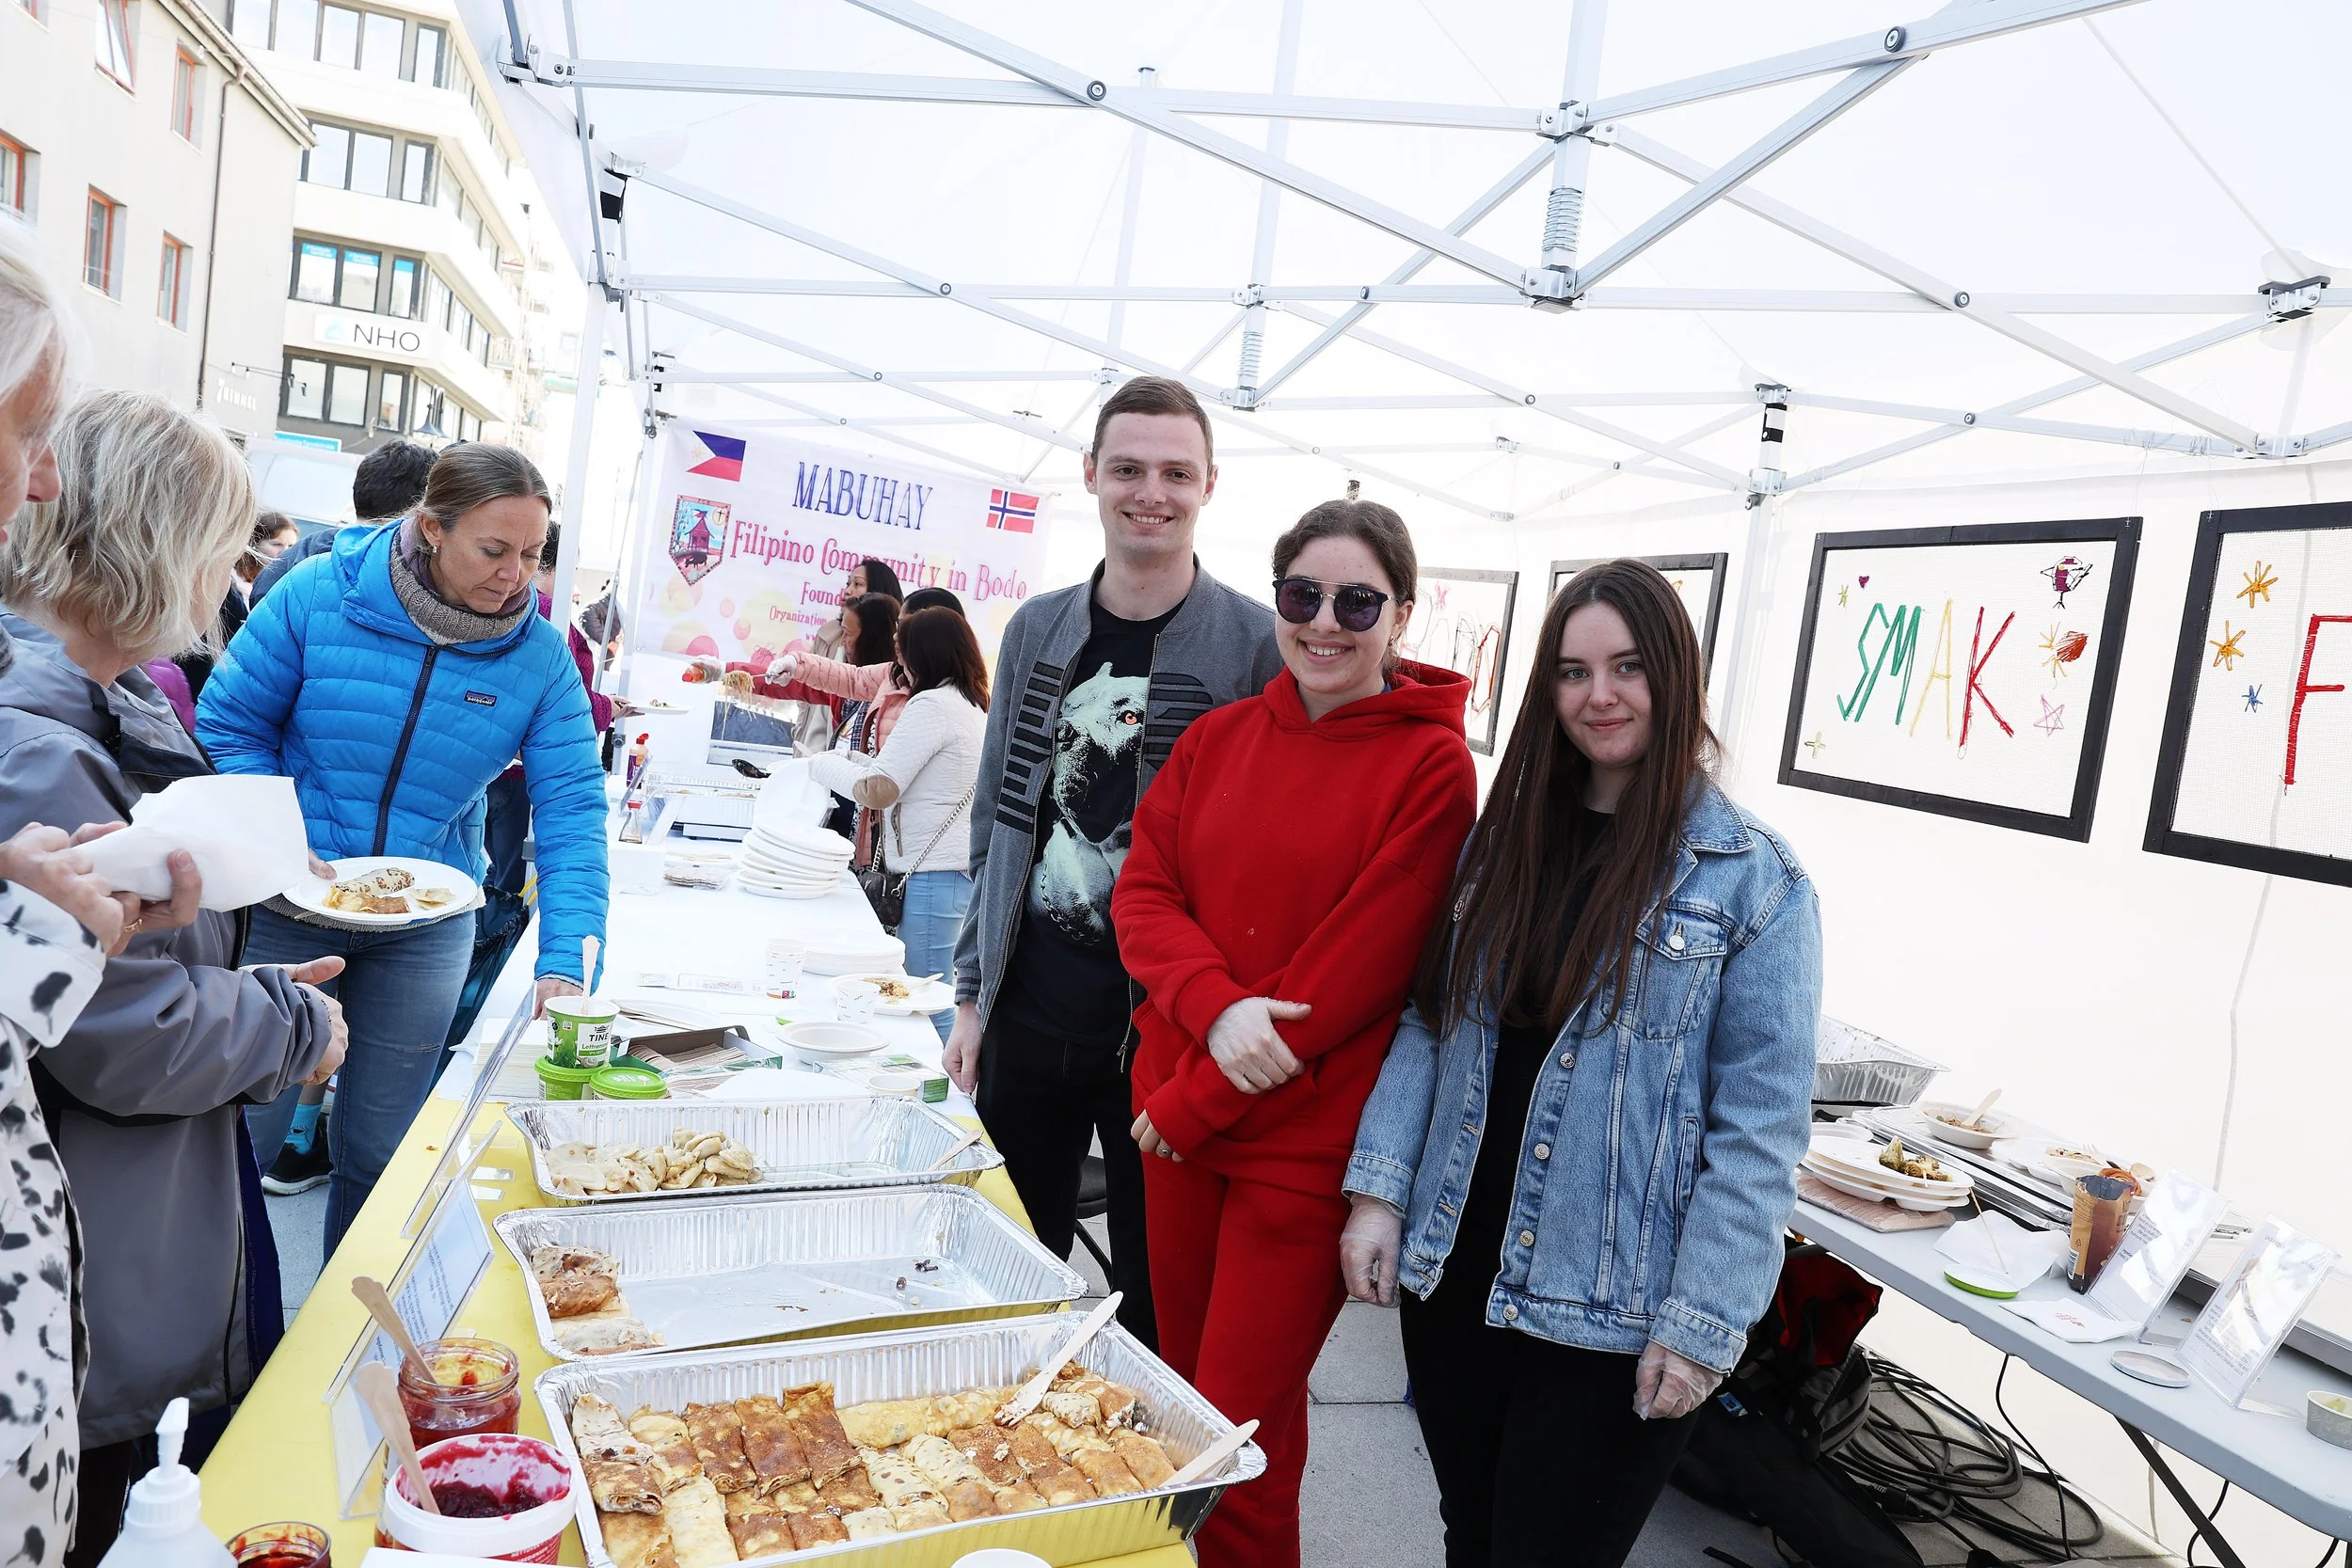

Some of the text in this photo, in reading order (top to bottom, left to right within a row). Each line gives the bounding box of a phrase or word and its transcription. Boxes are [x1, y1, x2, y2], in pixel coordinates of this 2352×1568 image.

[354, 323, 421, 352] NHO
[792, 461, 933, 531] MABUHAY
[730, 519, 815, 566] Filipino
[820, 538, 940, 590] Comnity
[946, 560, 967, 592] in
[1836, 596, 2015, 749] SMAK
[589, 1033, 609, 1041] TINE
